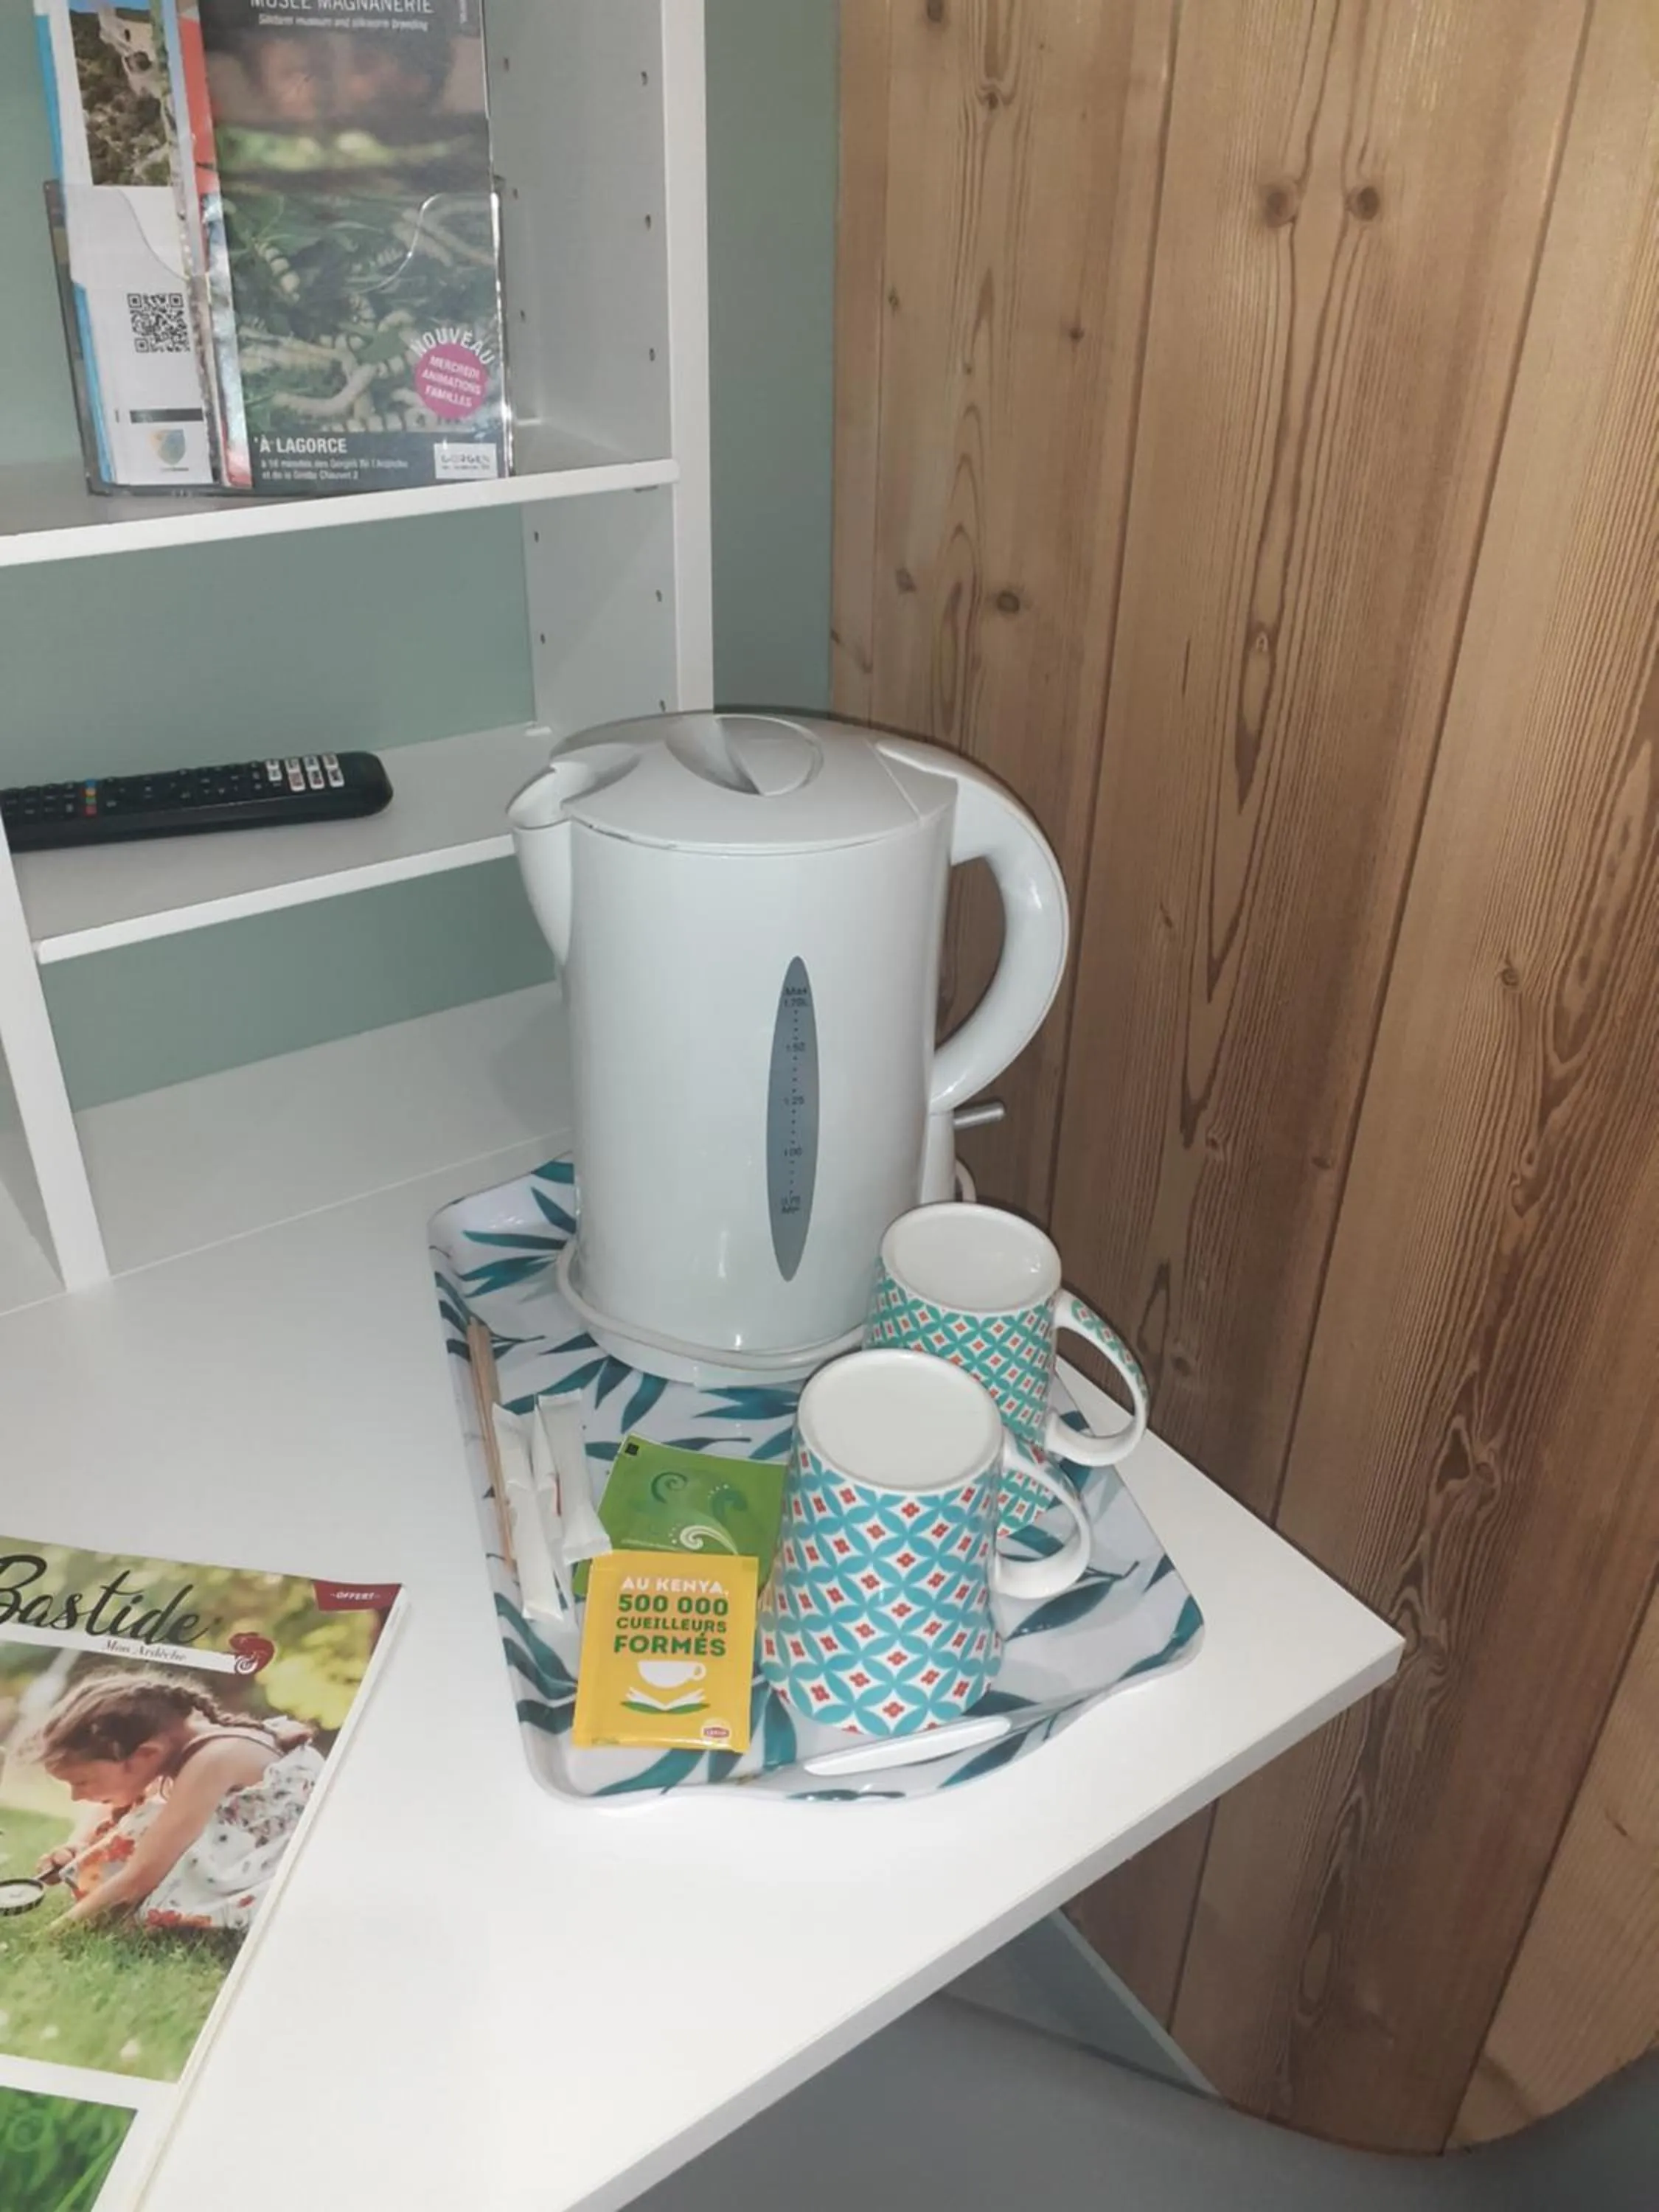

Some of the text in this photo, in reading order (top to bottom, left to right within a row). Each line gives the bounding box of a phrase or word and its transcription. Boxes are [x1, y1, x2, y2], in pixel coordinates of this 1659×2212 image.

[318, 0, 435, 14] MAGNANERIE
[410, 327, 495, 364] NOUVEAU
[422, 368, 482, 396] ANIMATIONS
[276, 437, 347, 454] LAGORCE
[622, 1576, 650, 1590] AU
[0, 1554, 209, 1646] Bastide
[618, 1593, 729, 1616] 500 000
[616, 1617, 727, 1634] CUEILLEURS
[613, 1632, 727, 1657] FORMÉS
